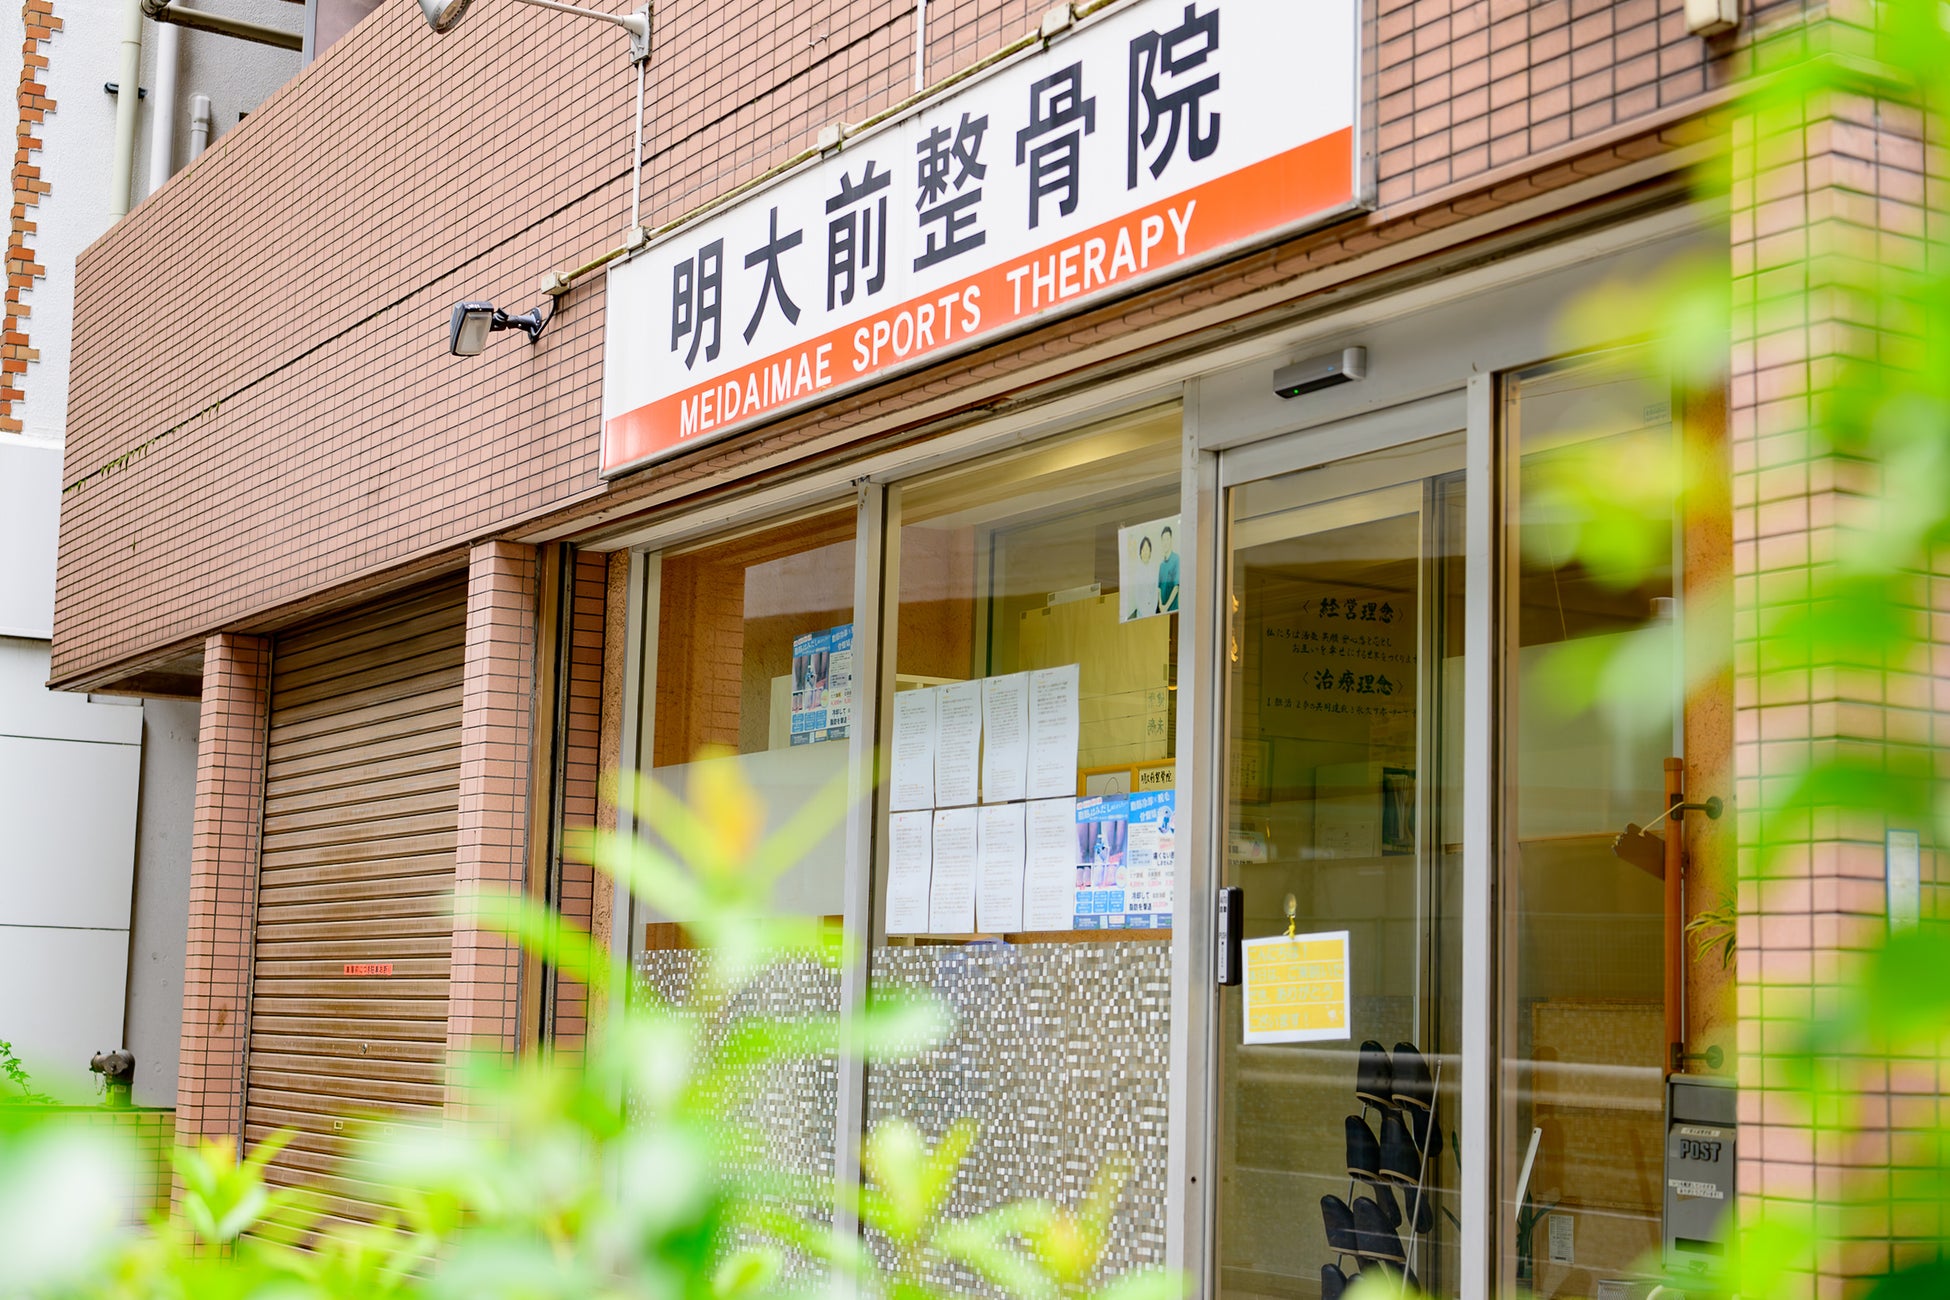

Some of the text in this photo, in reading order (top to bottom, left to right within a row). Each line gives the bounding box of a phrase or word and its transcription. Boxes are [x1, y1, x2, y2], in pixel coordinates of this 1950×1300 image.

[671, 3, 1221, 371] 明大前整骨院
[680, 200, 1197, 438] MEIDAIMAE SPORTS THERAPY
[1680, 1138, 1722, 1163] POST
